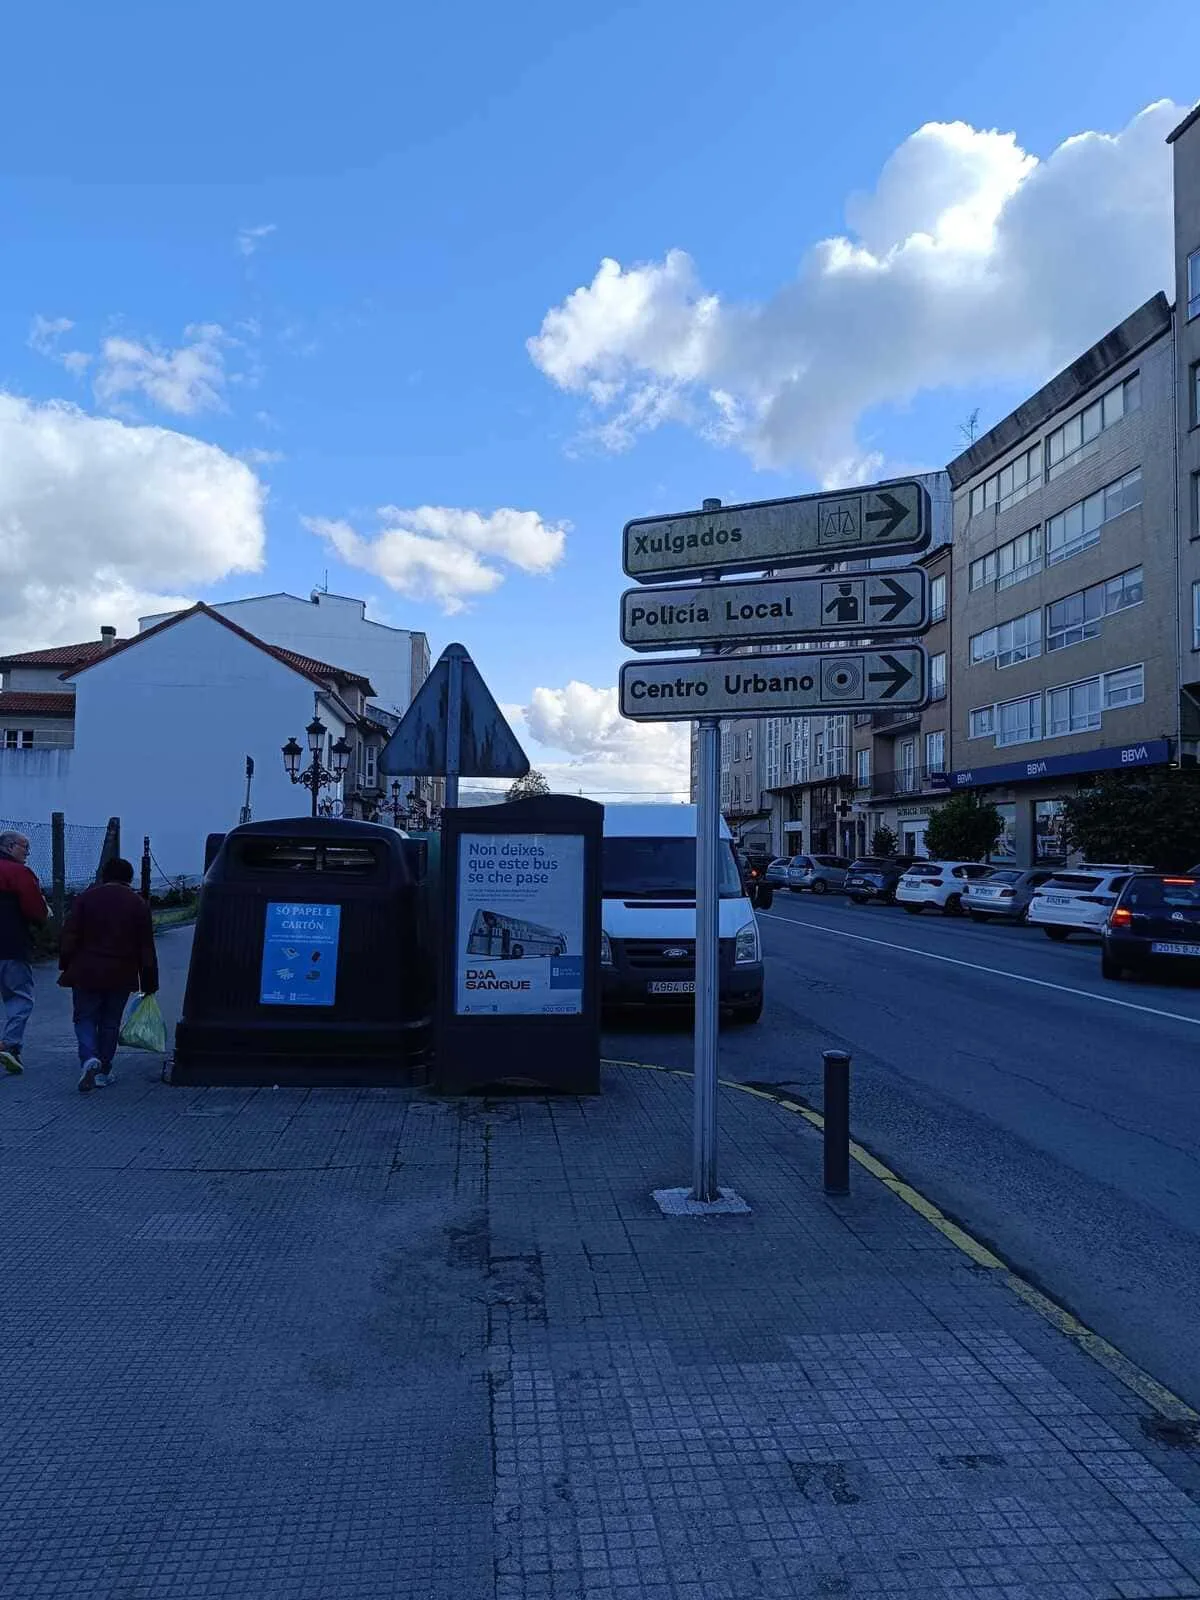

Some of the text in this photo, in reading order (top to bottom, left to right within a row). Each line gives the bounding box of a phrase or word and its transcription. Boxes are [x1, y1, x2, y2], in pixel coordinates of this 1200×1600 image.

[634, 527, 742, 555] Xulgados
[631, 597, 793, 627] Policía Local
[631, 672, 814, 699] Centro Urbano
[1121, 747, 1148, 762] BBVA
[1027, 762, 1047, 775] BBVA
[957, 773, 972, 784] BBVA
[469, 844, 545, 856] Non deixes
[468, 858, 558, 872] que este bus
[468, 871, 549, 886] se che pase
[275, 905, 333, 917] SÓ PAPEL E
[281, 919, 325, 930] CARTÓN
[1158, 944, 1180, 952] 2015
[465, 981, 531, 990] SANGUE
[653, 982, 696, 992] 4964 GB
